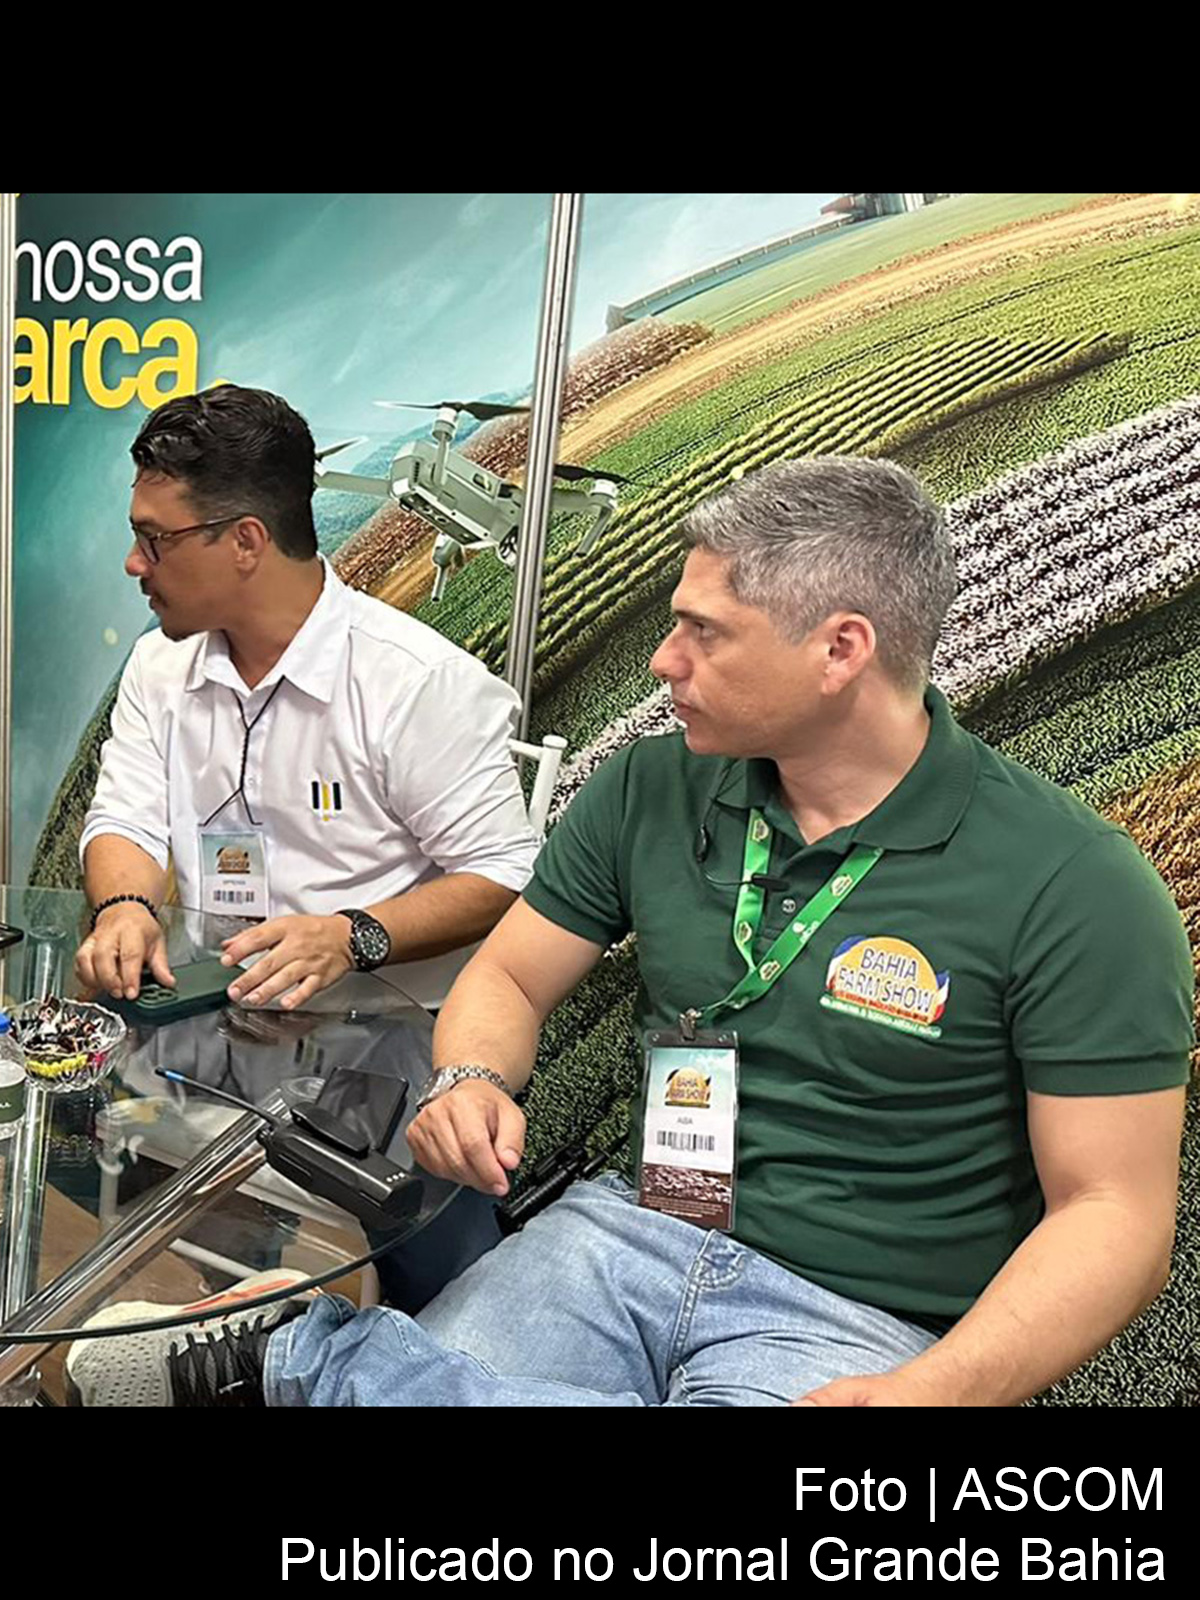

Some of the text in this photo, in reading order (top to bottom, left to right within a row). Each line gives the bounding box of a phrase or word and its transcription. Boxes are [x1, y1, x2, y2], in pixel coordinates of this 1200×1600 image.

[15, 236, 202, 303] nossa
[861, 948, 917, 981] BAHIA
[839, 967, 881, 997] FARM
[882, 979, 935, 1013] SHOW
